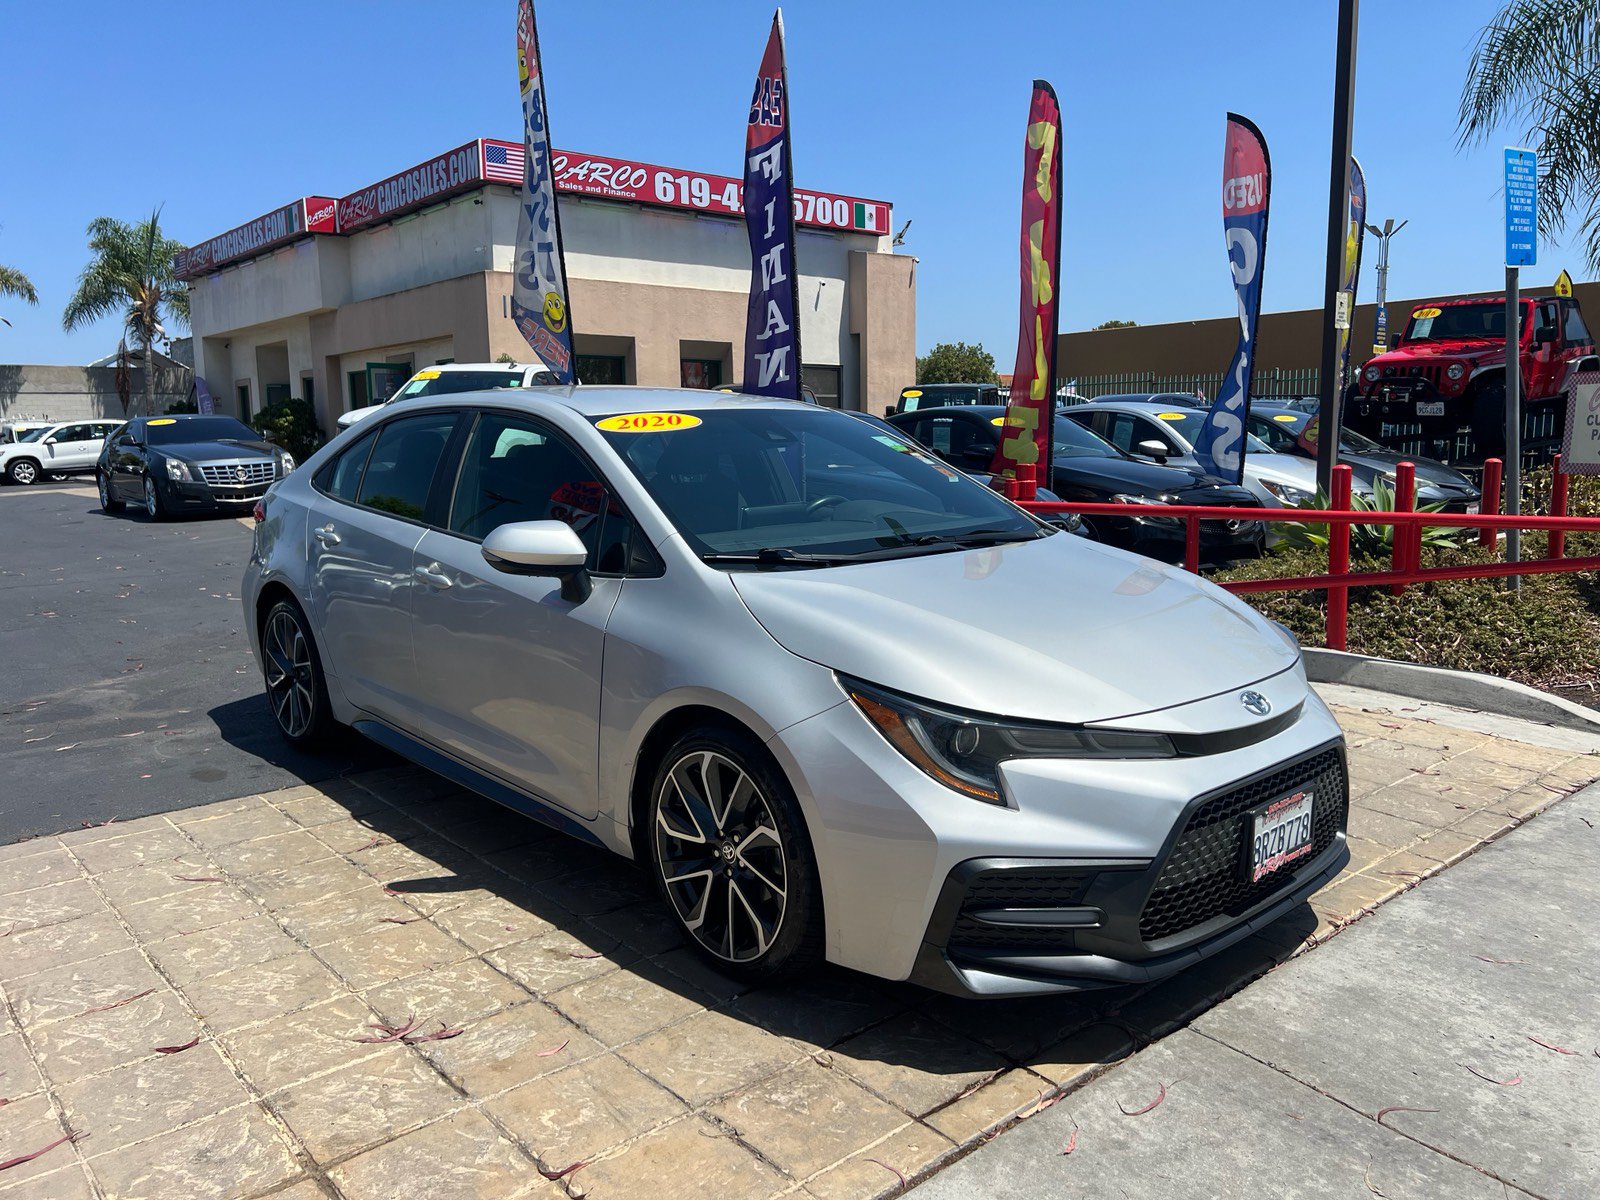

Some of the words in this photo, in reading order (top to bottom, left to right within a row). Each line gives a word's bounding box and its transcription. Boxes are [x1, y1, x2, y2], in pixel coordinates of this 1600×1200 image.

[377, 145, 479, 214] CARCOSALES.COM
[551, 155, 647, 190] CARCO
[558, 180, 583, 191] Sales
[585, 185, 601, 193] and
[603, 187, 636, 198] Finance
[307, 205, 334, 226] CARCO
[339, 189, 376, 226] CARCO
[211, 210, 287, 263] CARCOSALES.COM
[617, 414, 682, 430] 2020
[1253, 812, 1310, 866] 8RZB778
